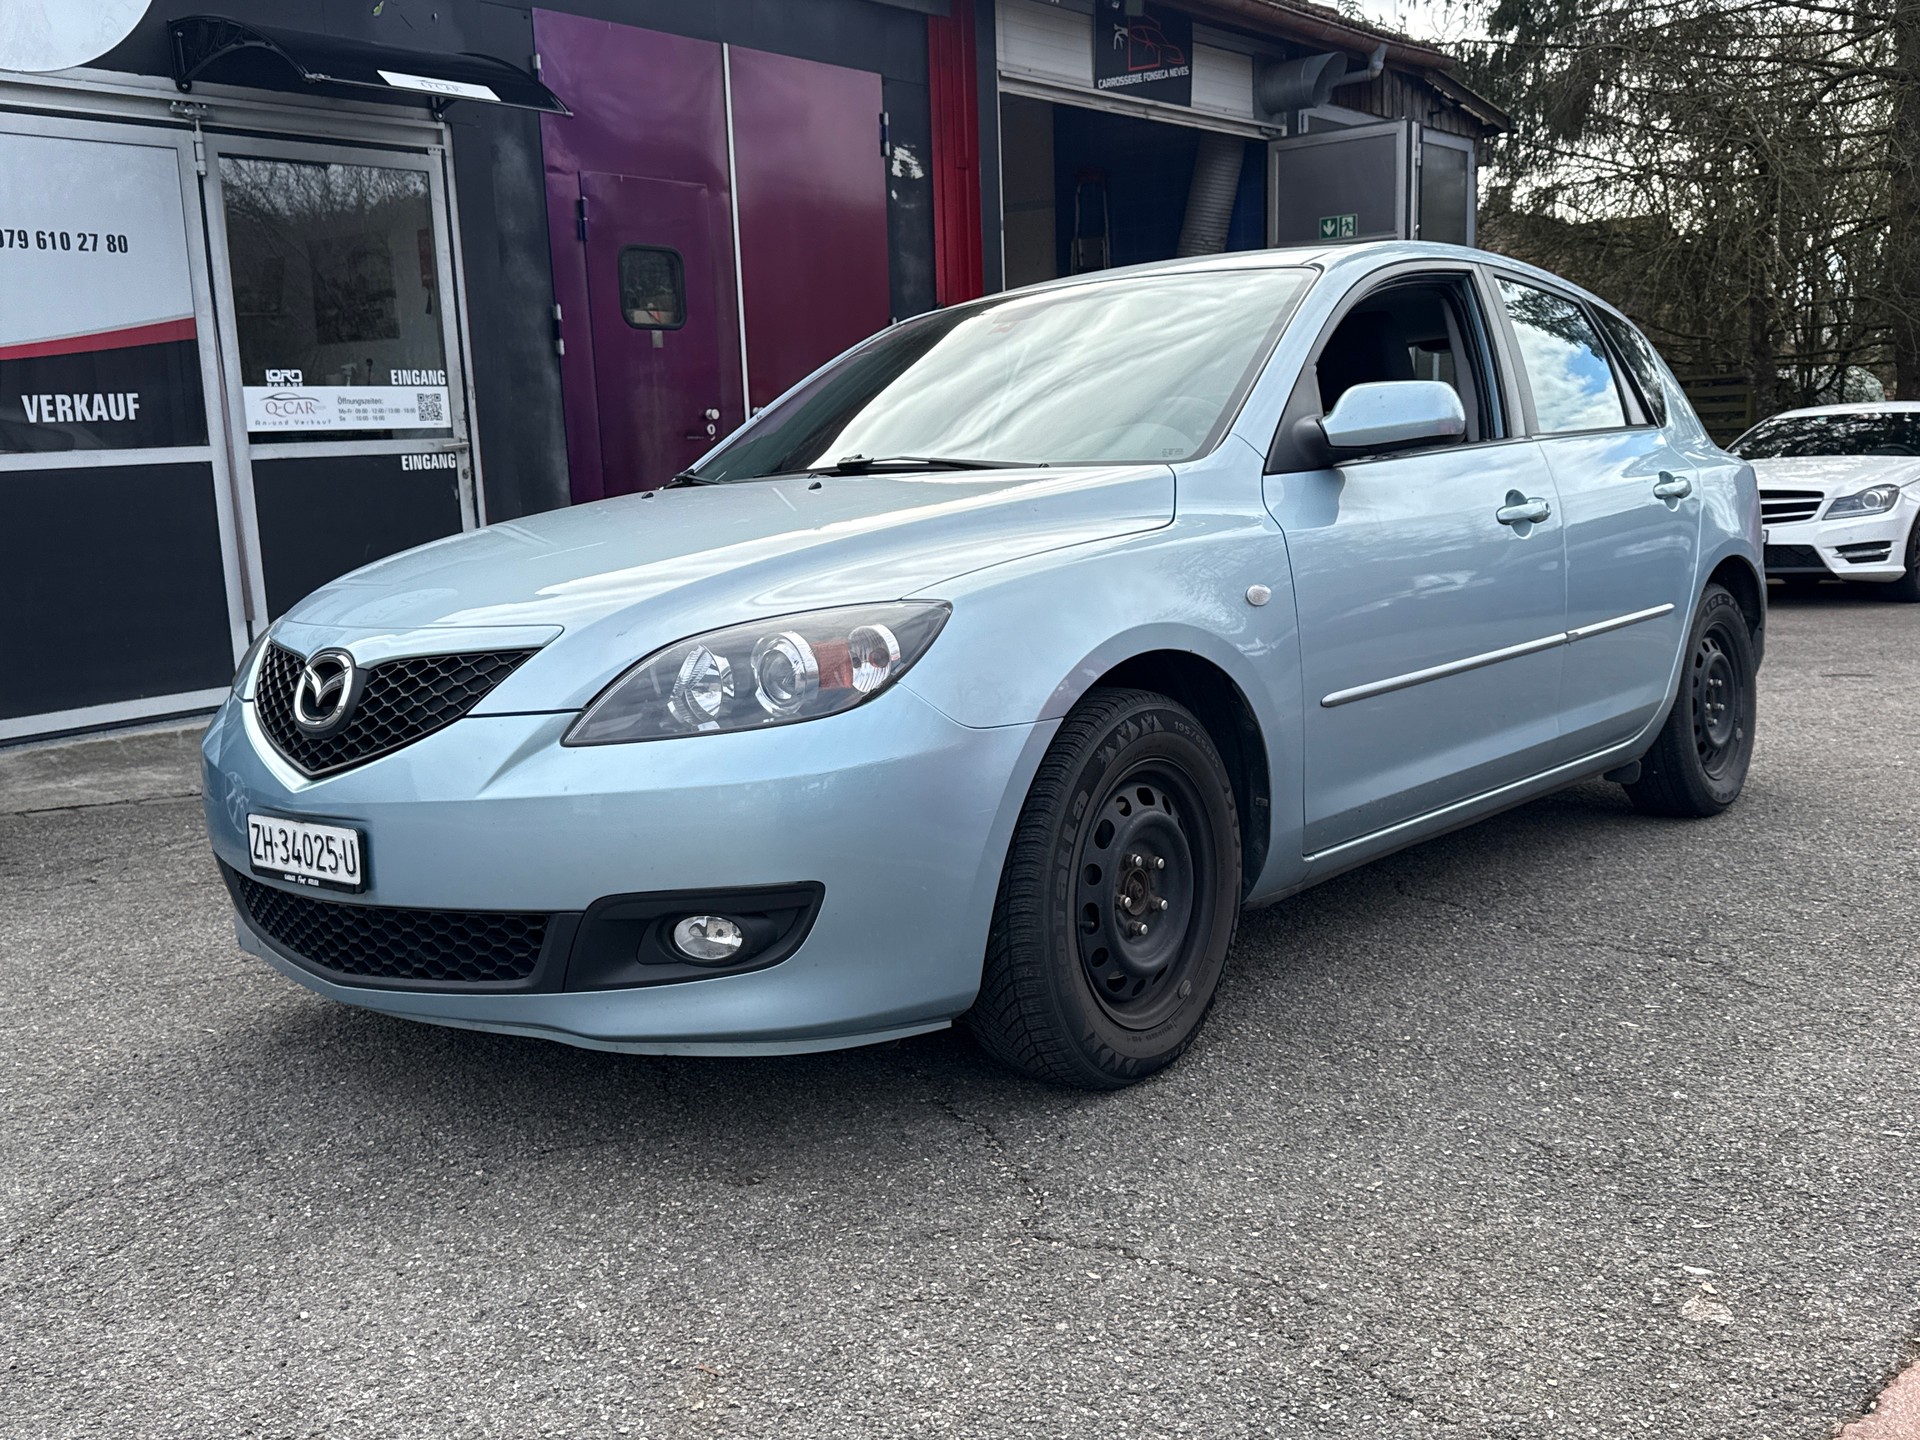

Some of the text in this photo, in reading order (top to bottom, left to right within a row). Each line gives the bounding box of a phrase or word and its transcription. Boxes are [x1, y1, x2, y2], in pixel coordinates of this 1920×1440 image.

[1098, 66, 1190, 90] CARROSSERIE FONSECA NEVES
[35, 230, 71, 251] 610
[77, 232, 98, 252] 27
[106, 234, 128, 253] 80
[265, 369, 303, 383] LORD
[390, 369, 446, 385] EINGANG
[21, 392, 140, 423] VERKAUF
[265, 400, 316, 417] Q-CAR
[401, 453, 457, 471] EINGANG
